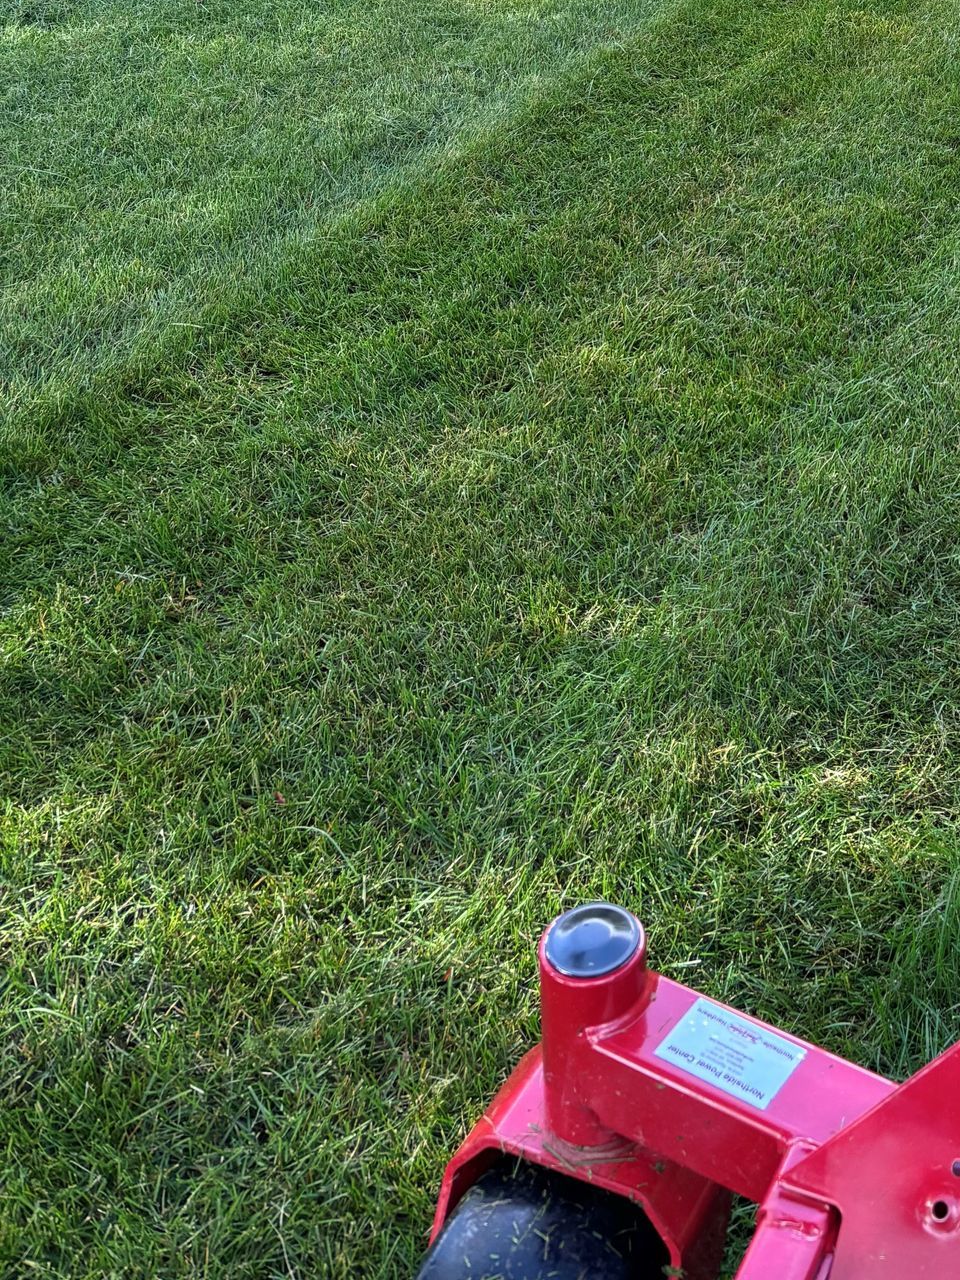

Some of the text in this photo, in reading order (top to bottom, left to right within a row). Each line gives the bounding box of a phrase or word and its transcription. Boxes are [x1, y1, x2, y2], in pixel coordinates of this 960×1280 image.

[667, 1044, 695, 1064] Center
[696, 1059, 723, 1079] Power
[723, 1073, 765, 1100] Northside
